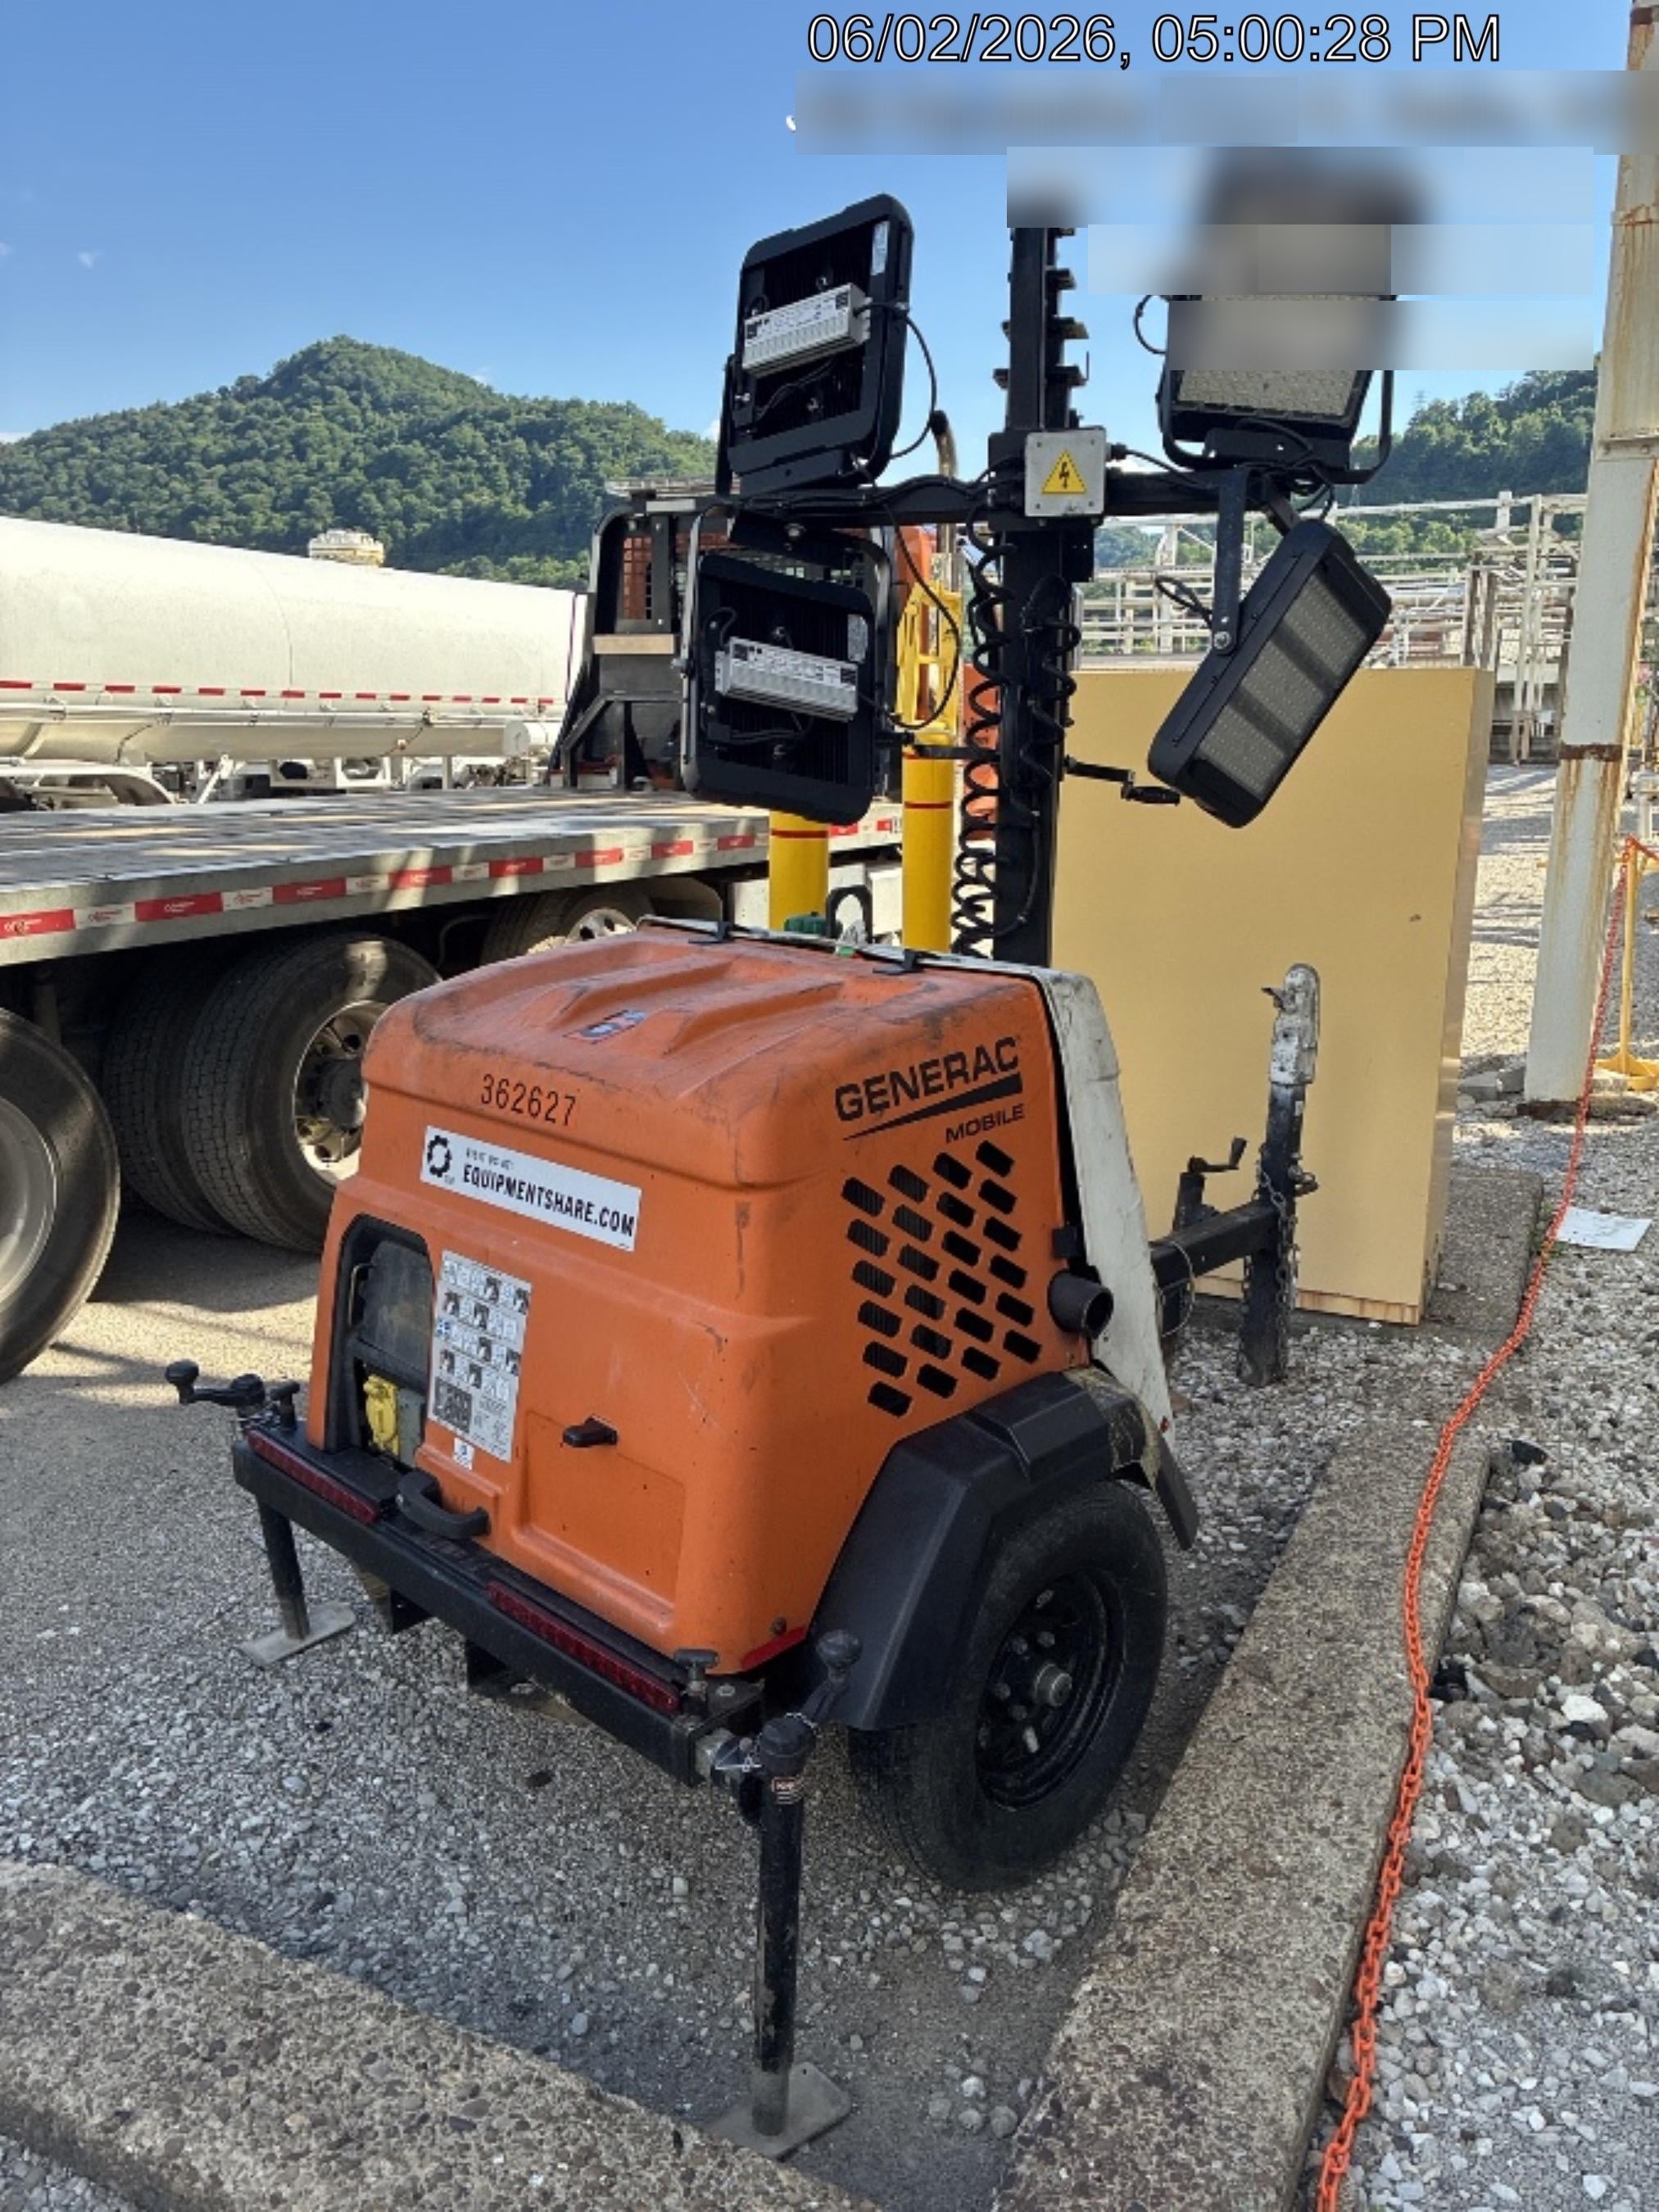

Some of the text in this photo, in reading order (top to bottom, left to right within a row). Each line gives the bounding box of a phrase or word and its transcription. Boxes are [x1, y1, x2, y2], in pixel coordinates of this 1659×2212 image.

[481, 1073, 577, 1127] 362627
[835, 1036, 1019, 1122] GENERAC
[945, 1104, 1024, 1144] MOBILE
[463, 1163, 635, 1237] EQUIPMENTSHARE.COM
